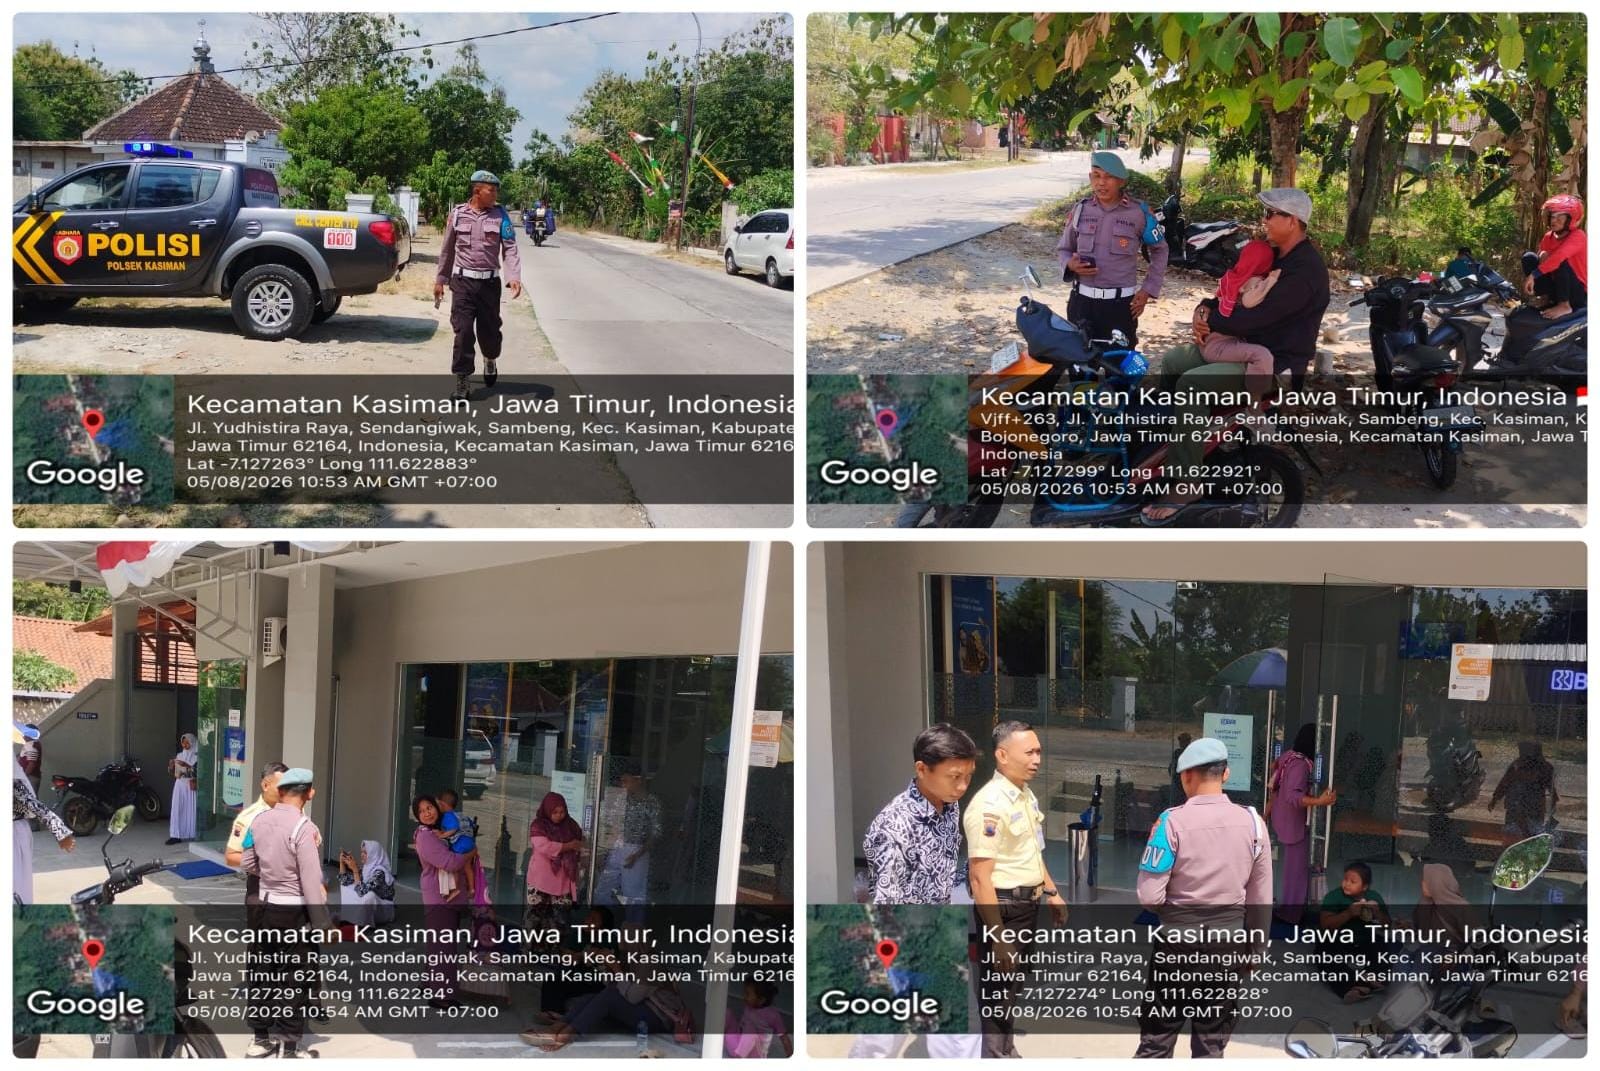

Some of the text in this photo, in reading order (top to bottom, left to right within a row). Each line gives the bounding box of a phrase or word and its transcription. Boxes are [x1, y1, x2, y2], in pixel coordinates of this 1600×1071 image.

[87, 232, 201, 257] POLISI
[327, 232, 353, 246] 110
[107, 261, 186, 271] POLSEK KASIMAN
